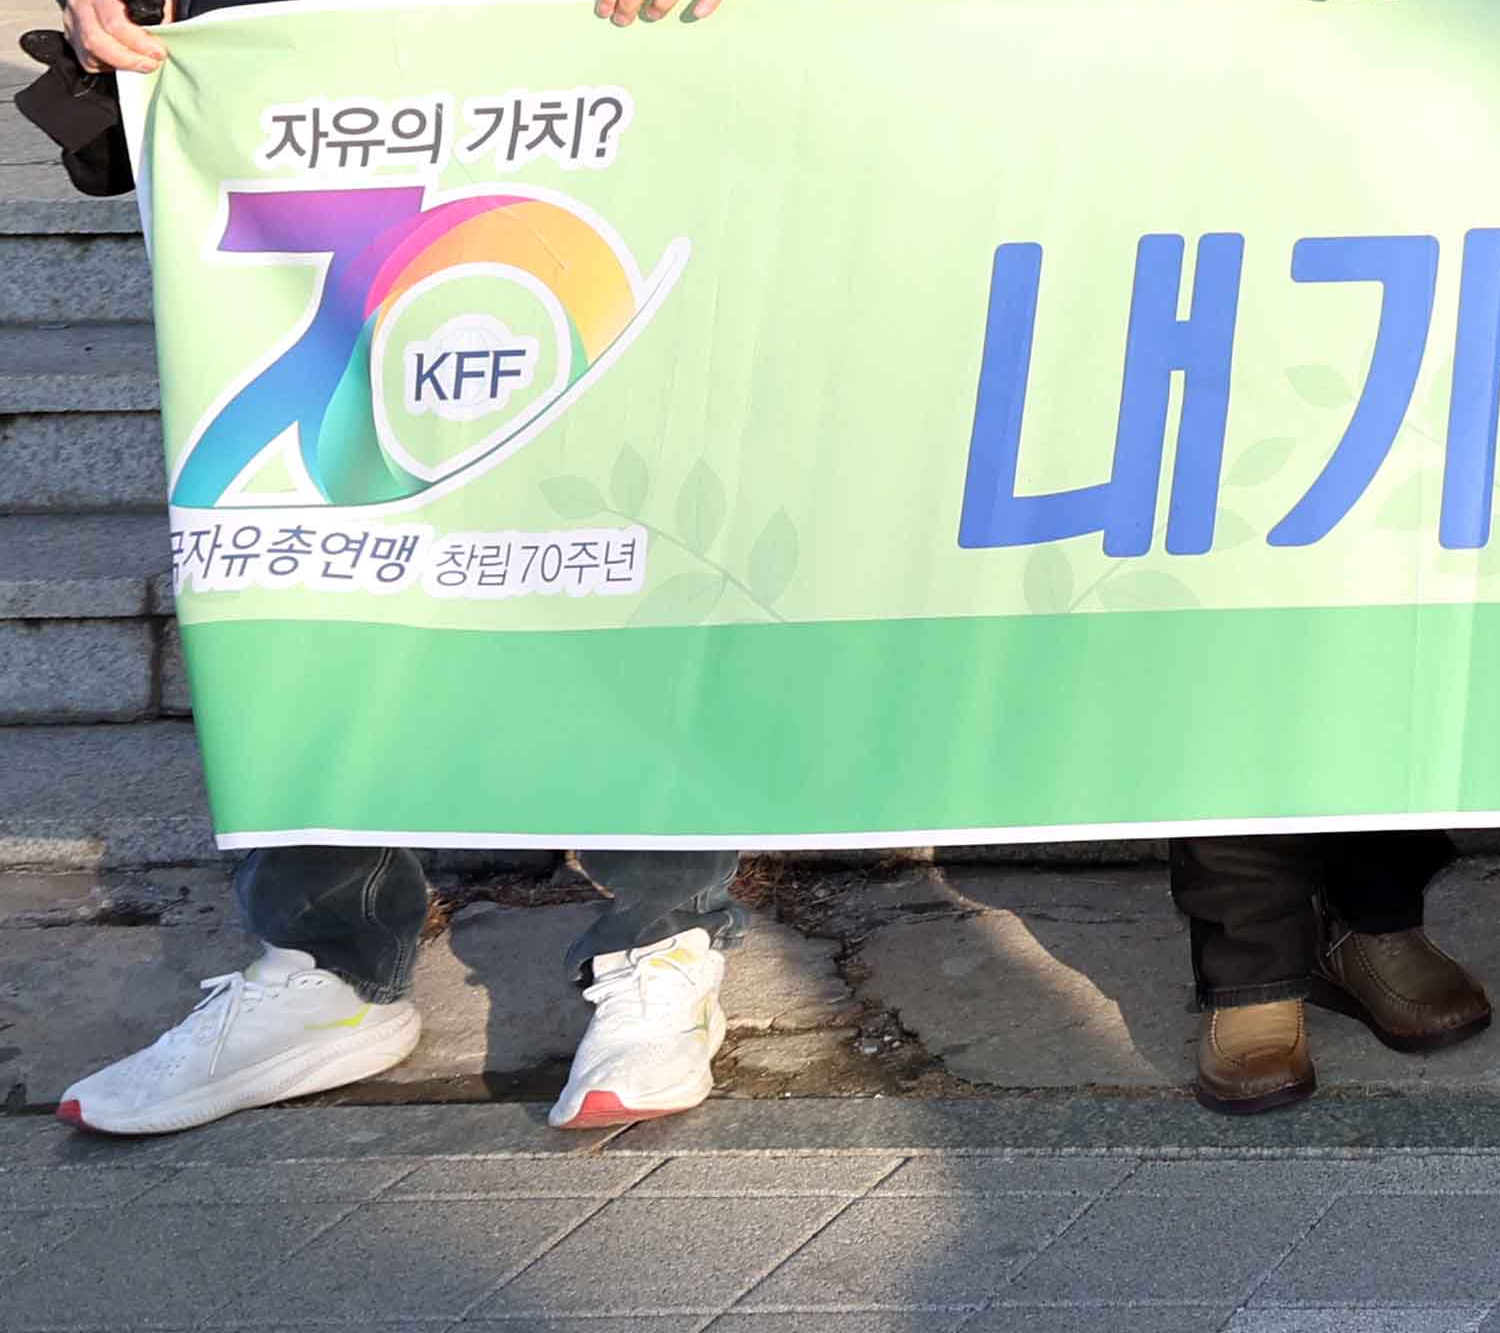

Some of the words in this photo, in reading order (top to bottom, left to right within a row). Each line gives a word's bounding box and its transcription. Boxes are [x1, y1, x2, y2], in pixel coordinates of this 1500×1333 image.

[265, 100, 444, 168] 자유의
[467, 96, 625, 161] 가치?
[413, 347, 527, 403] KFF
